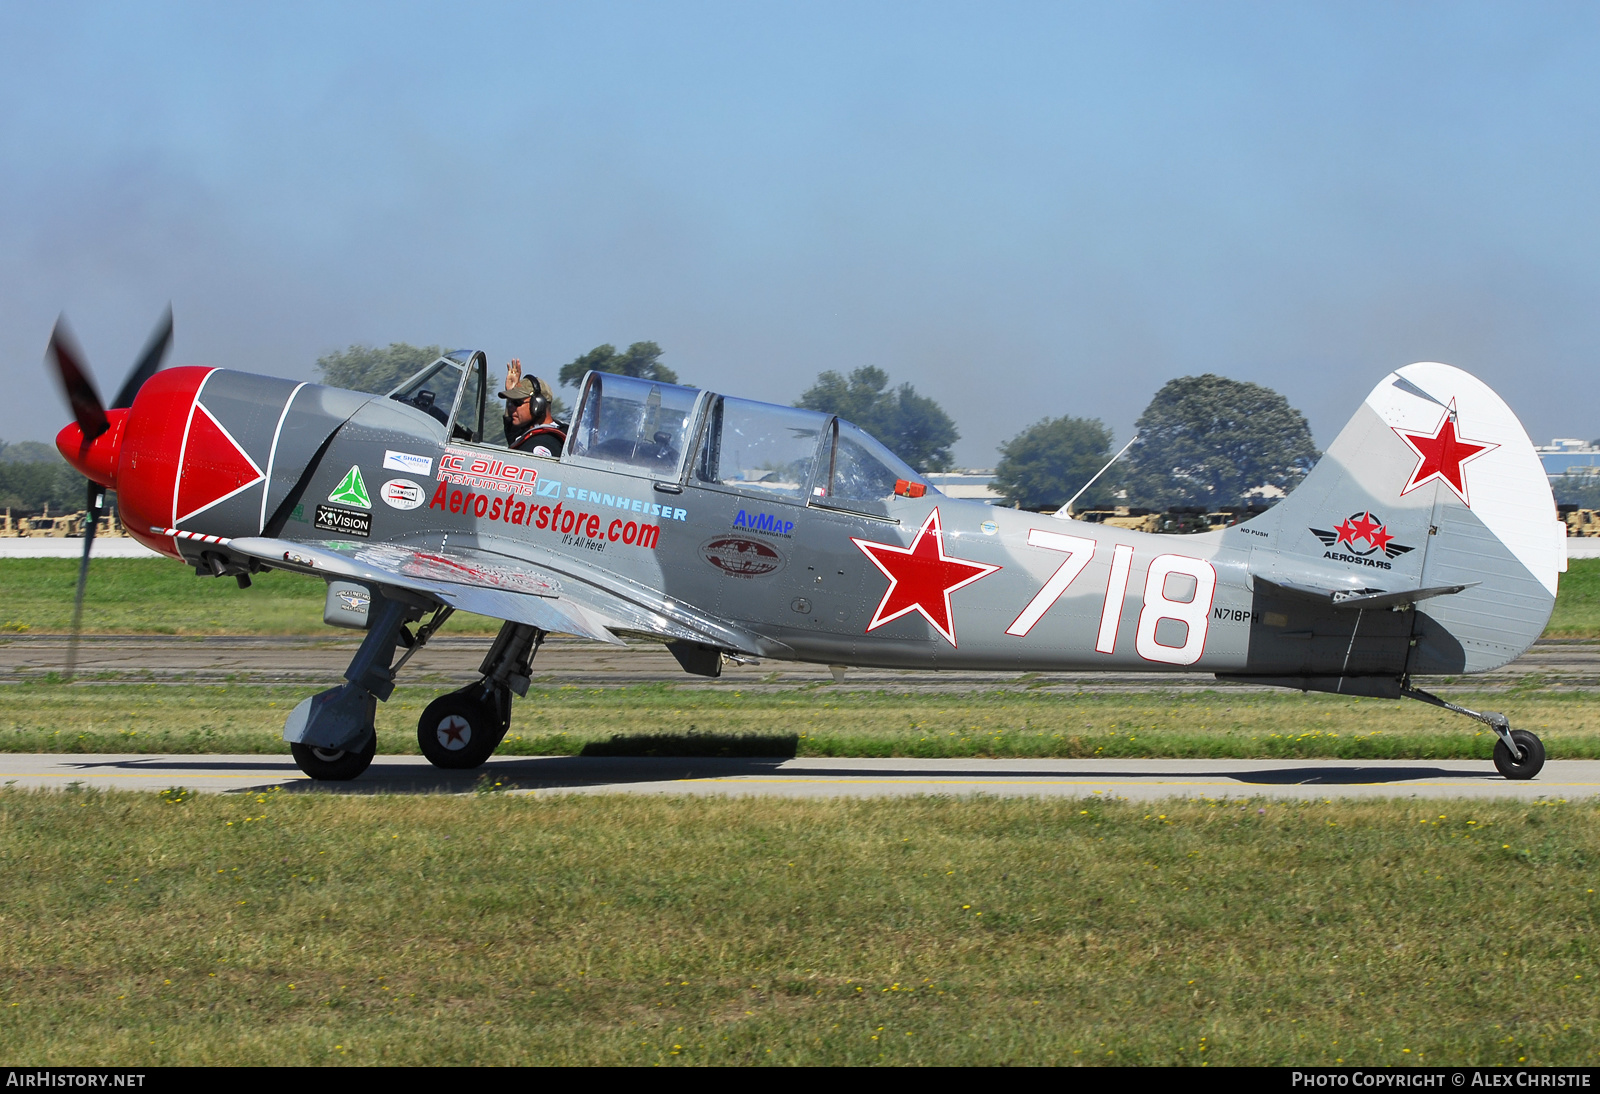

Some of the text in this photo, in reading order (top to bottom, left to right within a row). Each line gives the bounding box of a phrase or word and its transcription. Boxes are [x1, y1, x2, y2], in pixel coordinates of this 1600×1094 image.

[402, 454, 430, 465] SHADIN
[439, 454, 539, 483] rc allen
[390, 488, 415, 498] CHAMPION
[436, 471, 534, 497] instruments
[565, 486, 688, 522] SENNHEISER
[429, 480, 661, 549] Aerostarstore.com
[732, 525, 792, 539] SATELLITE NAVIGATION
[1240, 527, 1269, 538] NO PUSH
[561, 533, 607, 553] It's All Here!
[1004, 528, 1217, 666] 718
[1214, 608, 1259, 625] N718PH
